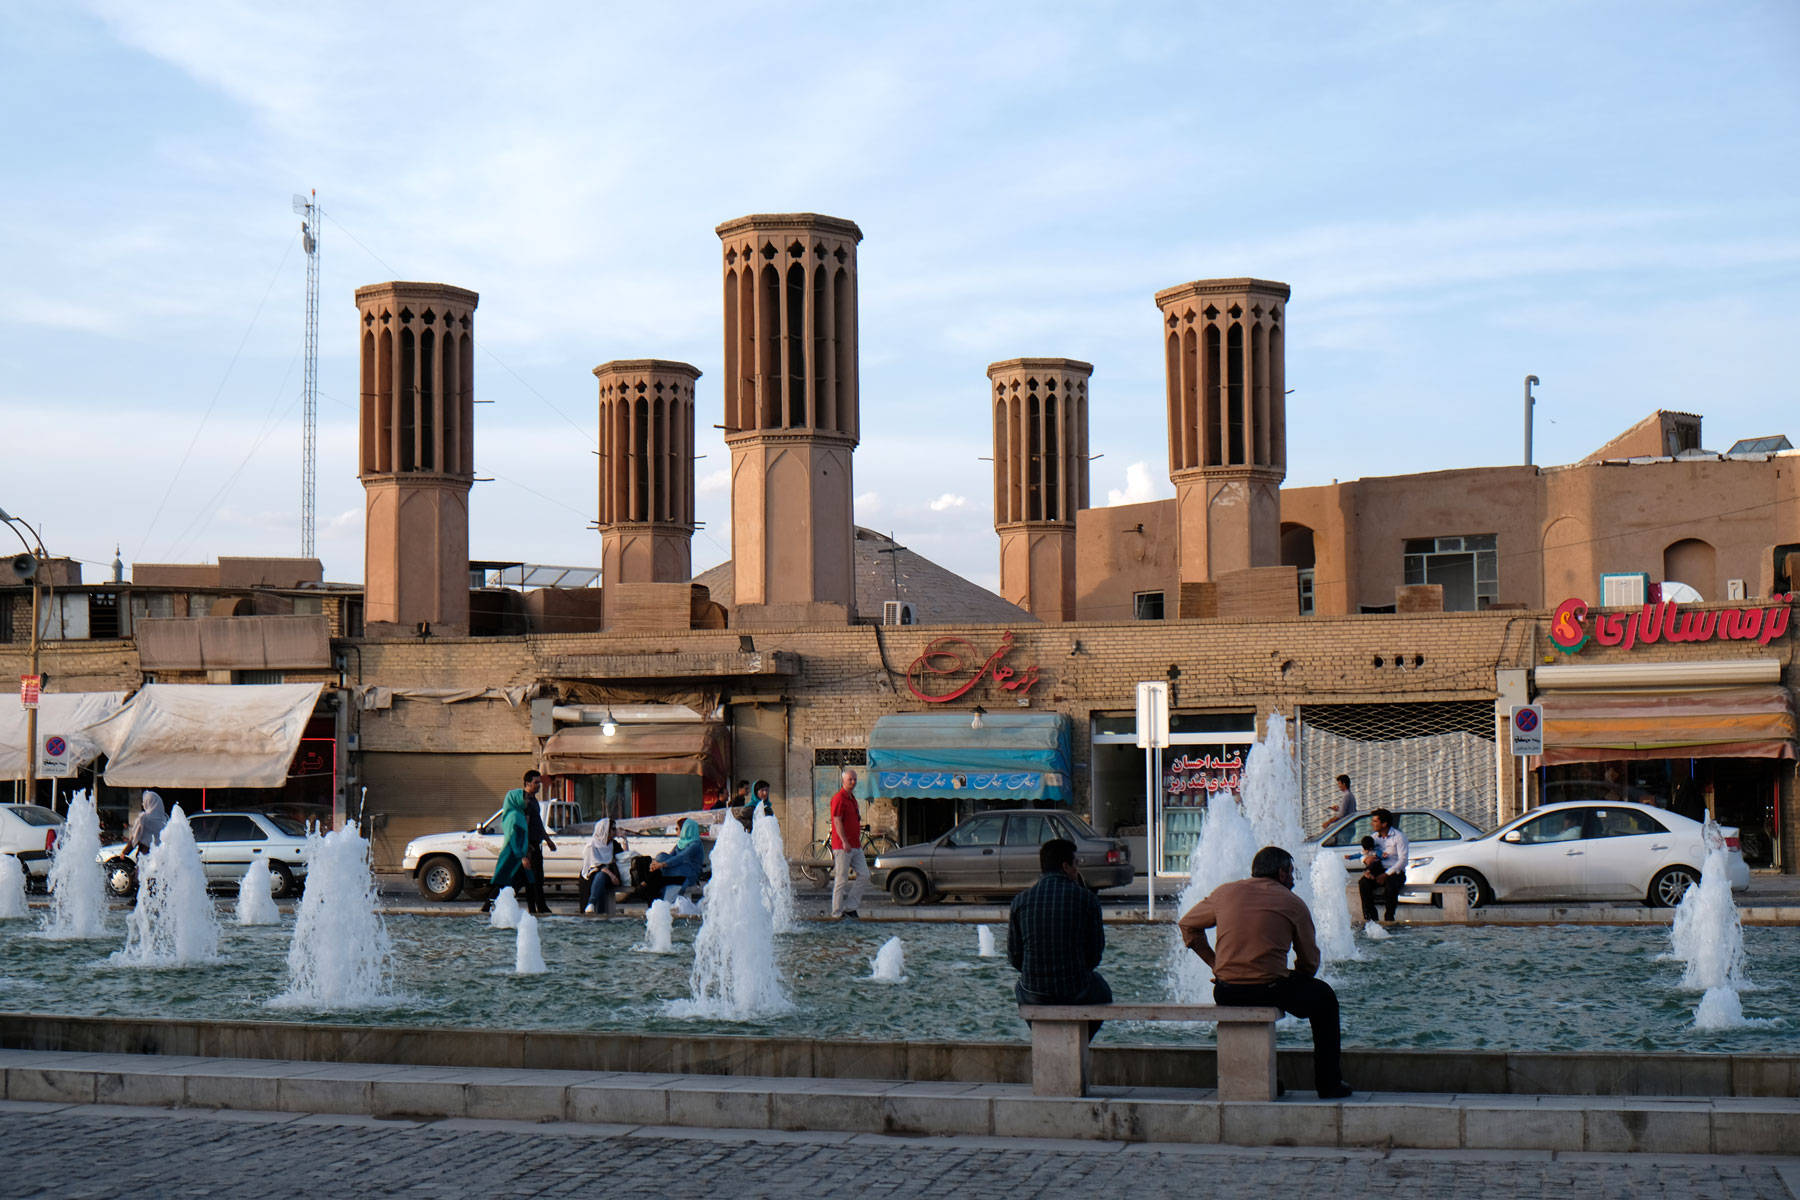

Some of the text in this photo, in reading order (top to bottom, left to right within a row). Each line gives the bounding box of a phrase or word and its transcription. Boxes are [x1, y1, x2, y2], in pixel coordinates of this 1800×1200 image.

[1594, 592, 1794, 651] ترمه سالاری
[997, 664, 1039, 695] ترمه
[1171, 750, 1242, 773] قند احسان
[1167, 772, 1242, 794] لیدی قند ریز
